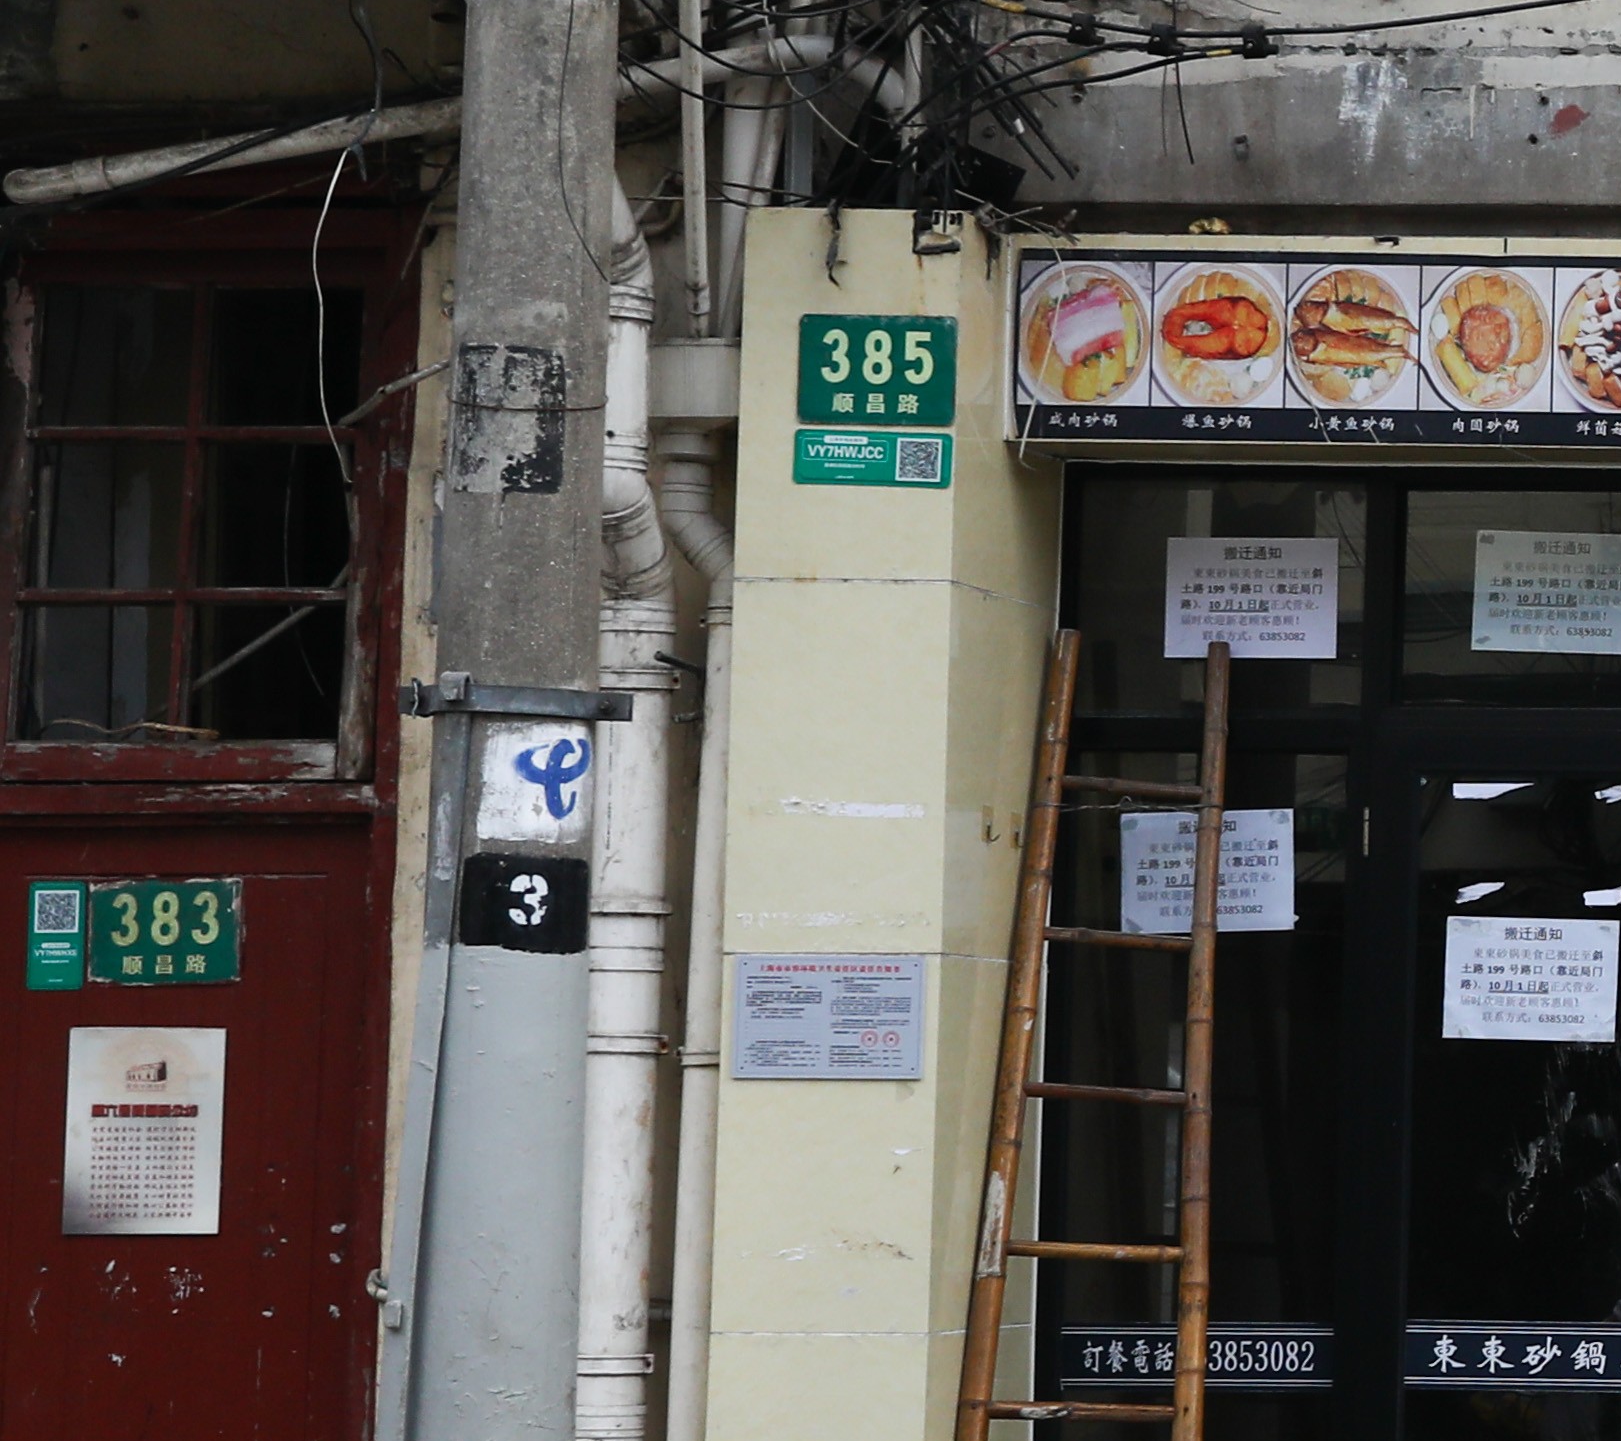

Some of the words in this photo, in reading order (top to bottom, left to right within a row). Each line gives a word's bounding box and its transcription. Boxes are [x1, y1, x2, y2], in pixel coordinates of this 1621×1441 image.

[821, 329, 934, 385] 385
[832, 393, 920, 414] 顺昌路
[807, 444, 884, 459] VY7HWJCC
[1224, 546, 1282, 560] 搬迁通知
[1534, 541, 1591, 555] 搬迁通知
[508, 874, 549, 925] 3
[111, 891, 220, 946] 383
[1504, 927, 1562, 941] 搬迁通知
[122, 955, 206, 974] 顺昌路
[1083, 1339, 1175, 1373] 訂餐電話
[1204, 1340, 1316, 1373] 3853082
